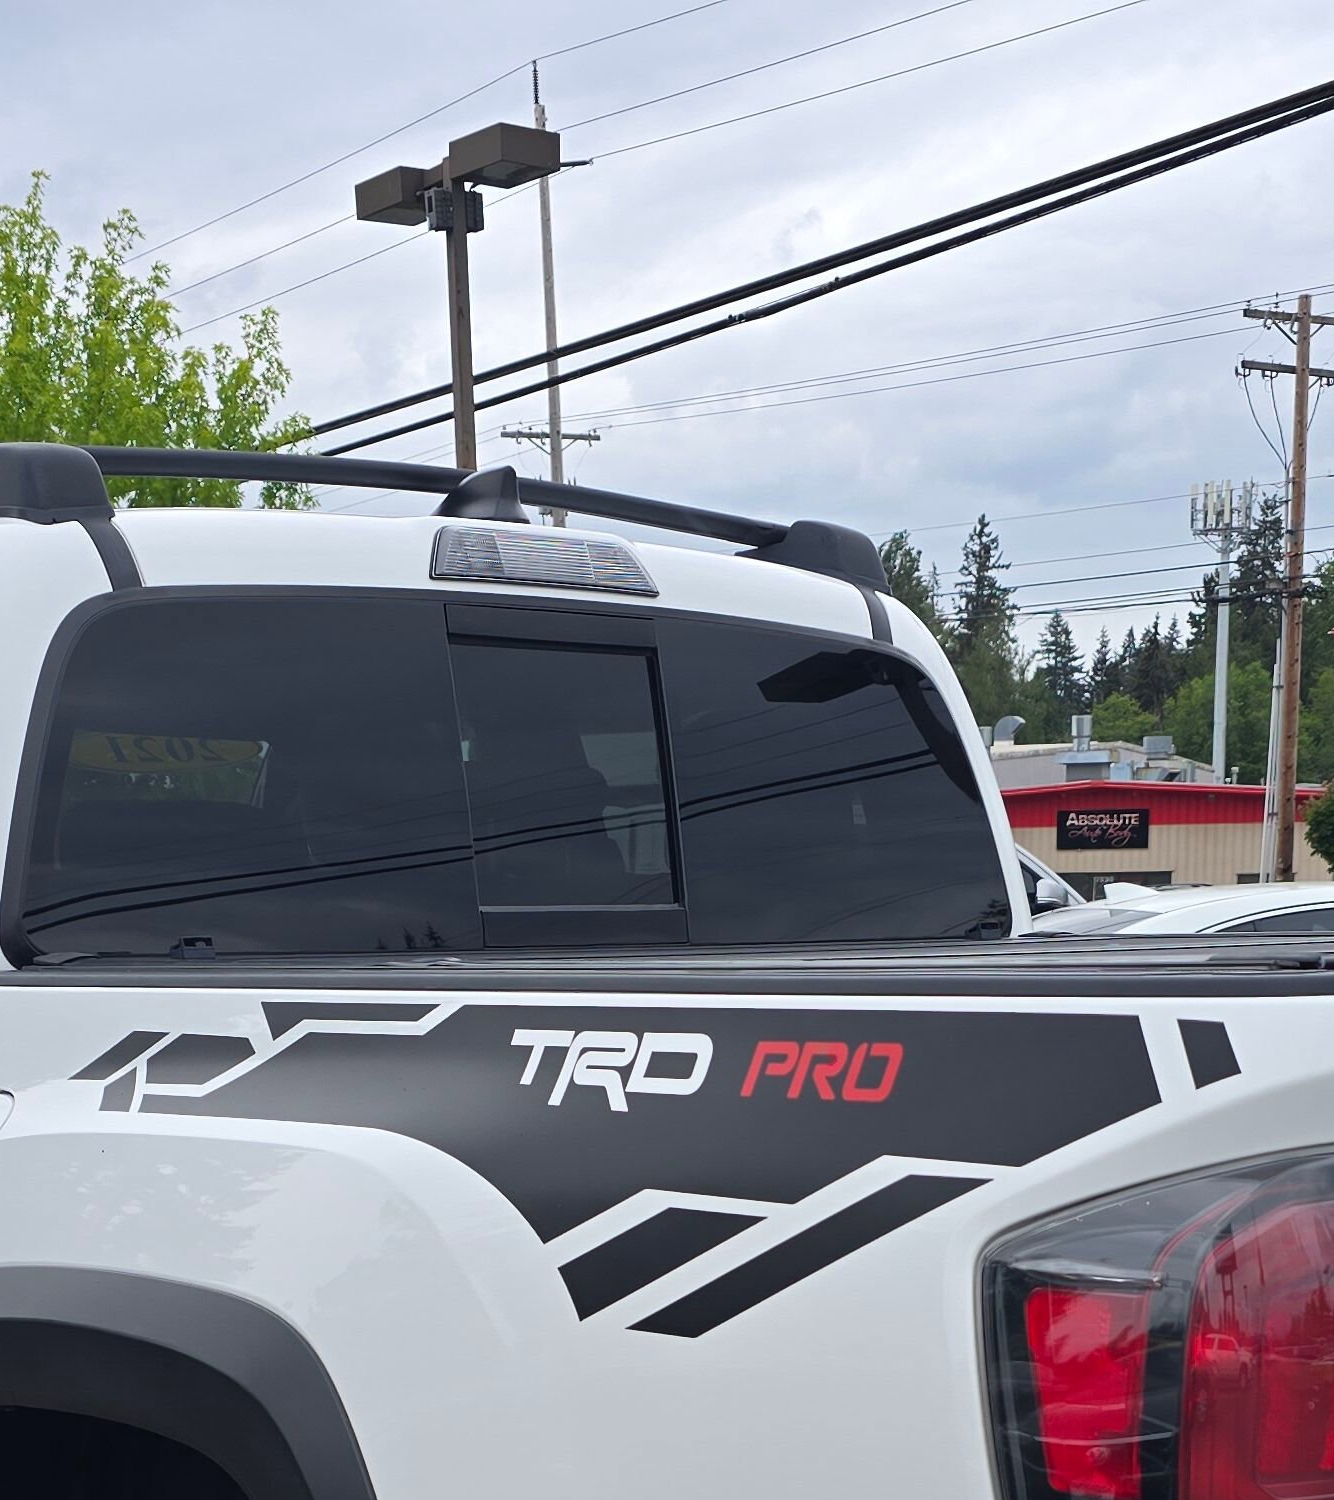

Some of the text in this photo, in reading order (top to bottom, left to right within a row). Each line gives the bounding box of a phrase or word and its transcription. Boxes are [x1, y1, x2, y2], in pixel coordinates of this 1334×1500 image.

[1066, 813, 1140, 826] ABSOLUTE
[510, 1028, 904, 1113] TRD PRO
